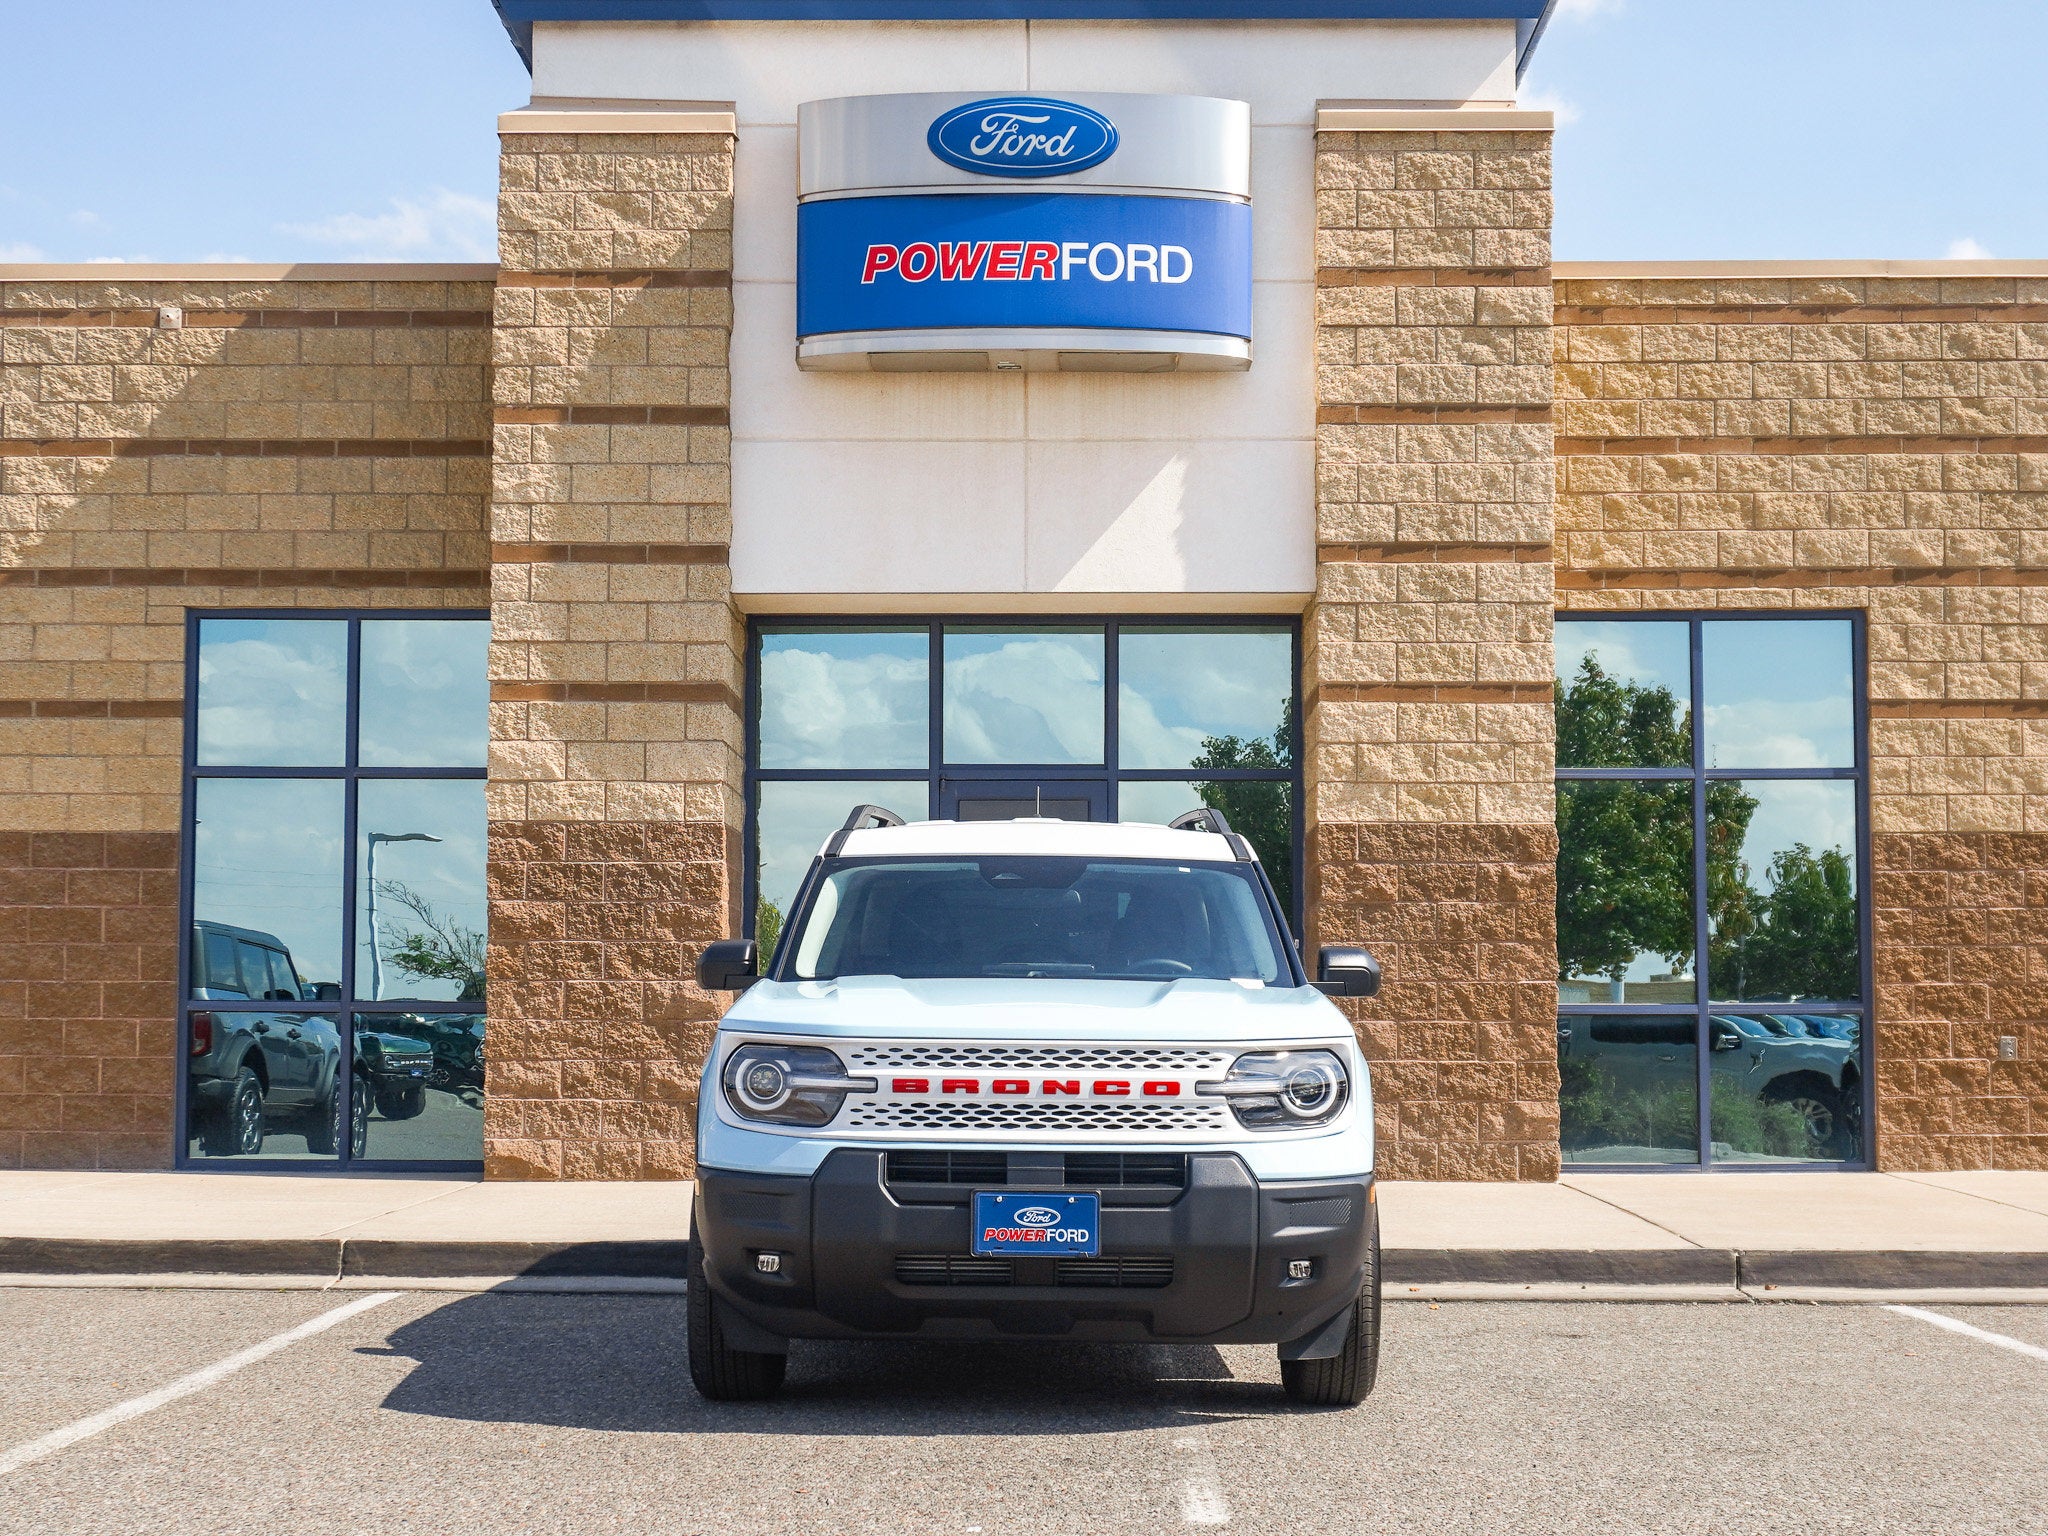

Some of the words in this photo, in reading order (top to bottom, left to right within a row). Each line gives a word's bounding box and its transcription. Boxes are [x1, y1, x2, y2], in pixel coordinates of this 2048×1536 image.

[970, 112, 1078, 157] Ford
[892, 1078, 1180, 1096] BRONCO
[1023, 1210, 1051, 1223] Ford
